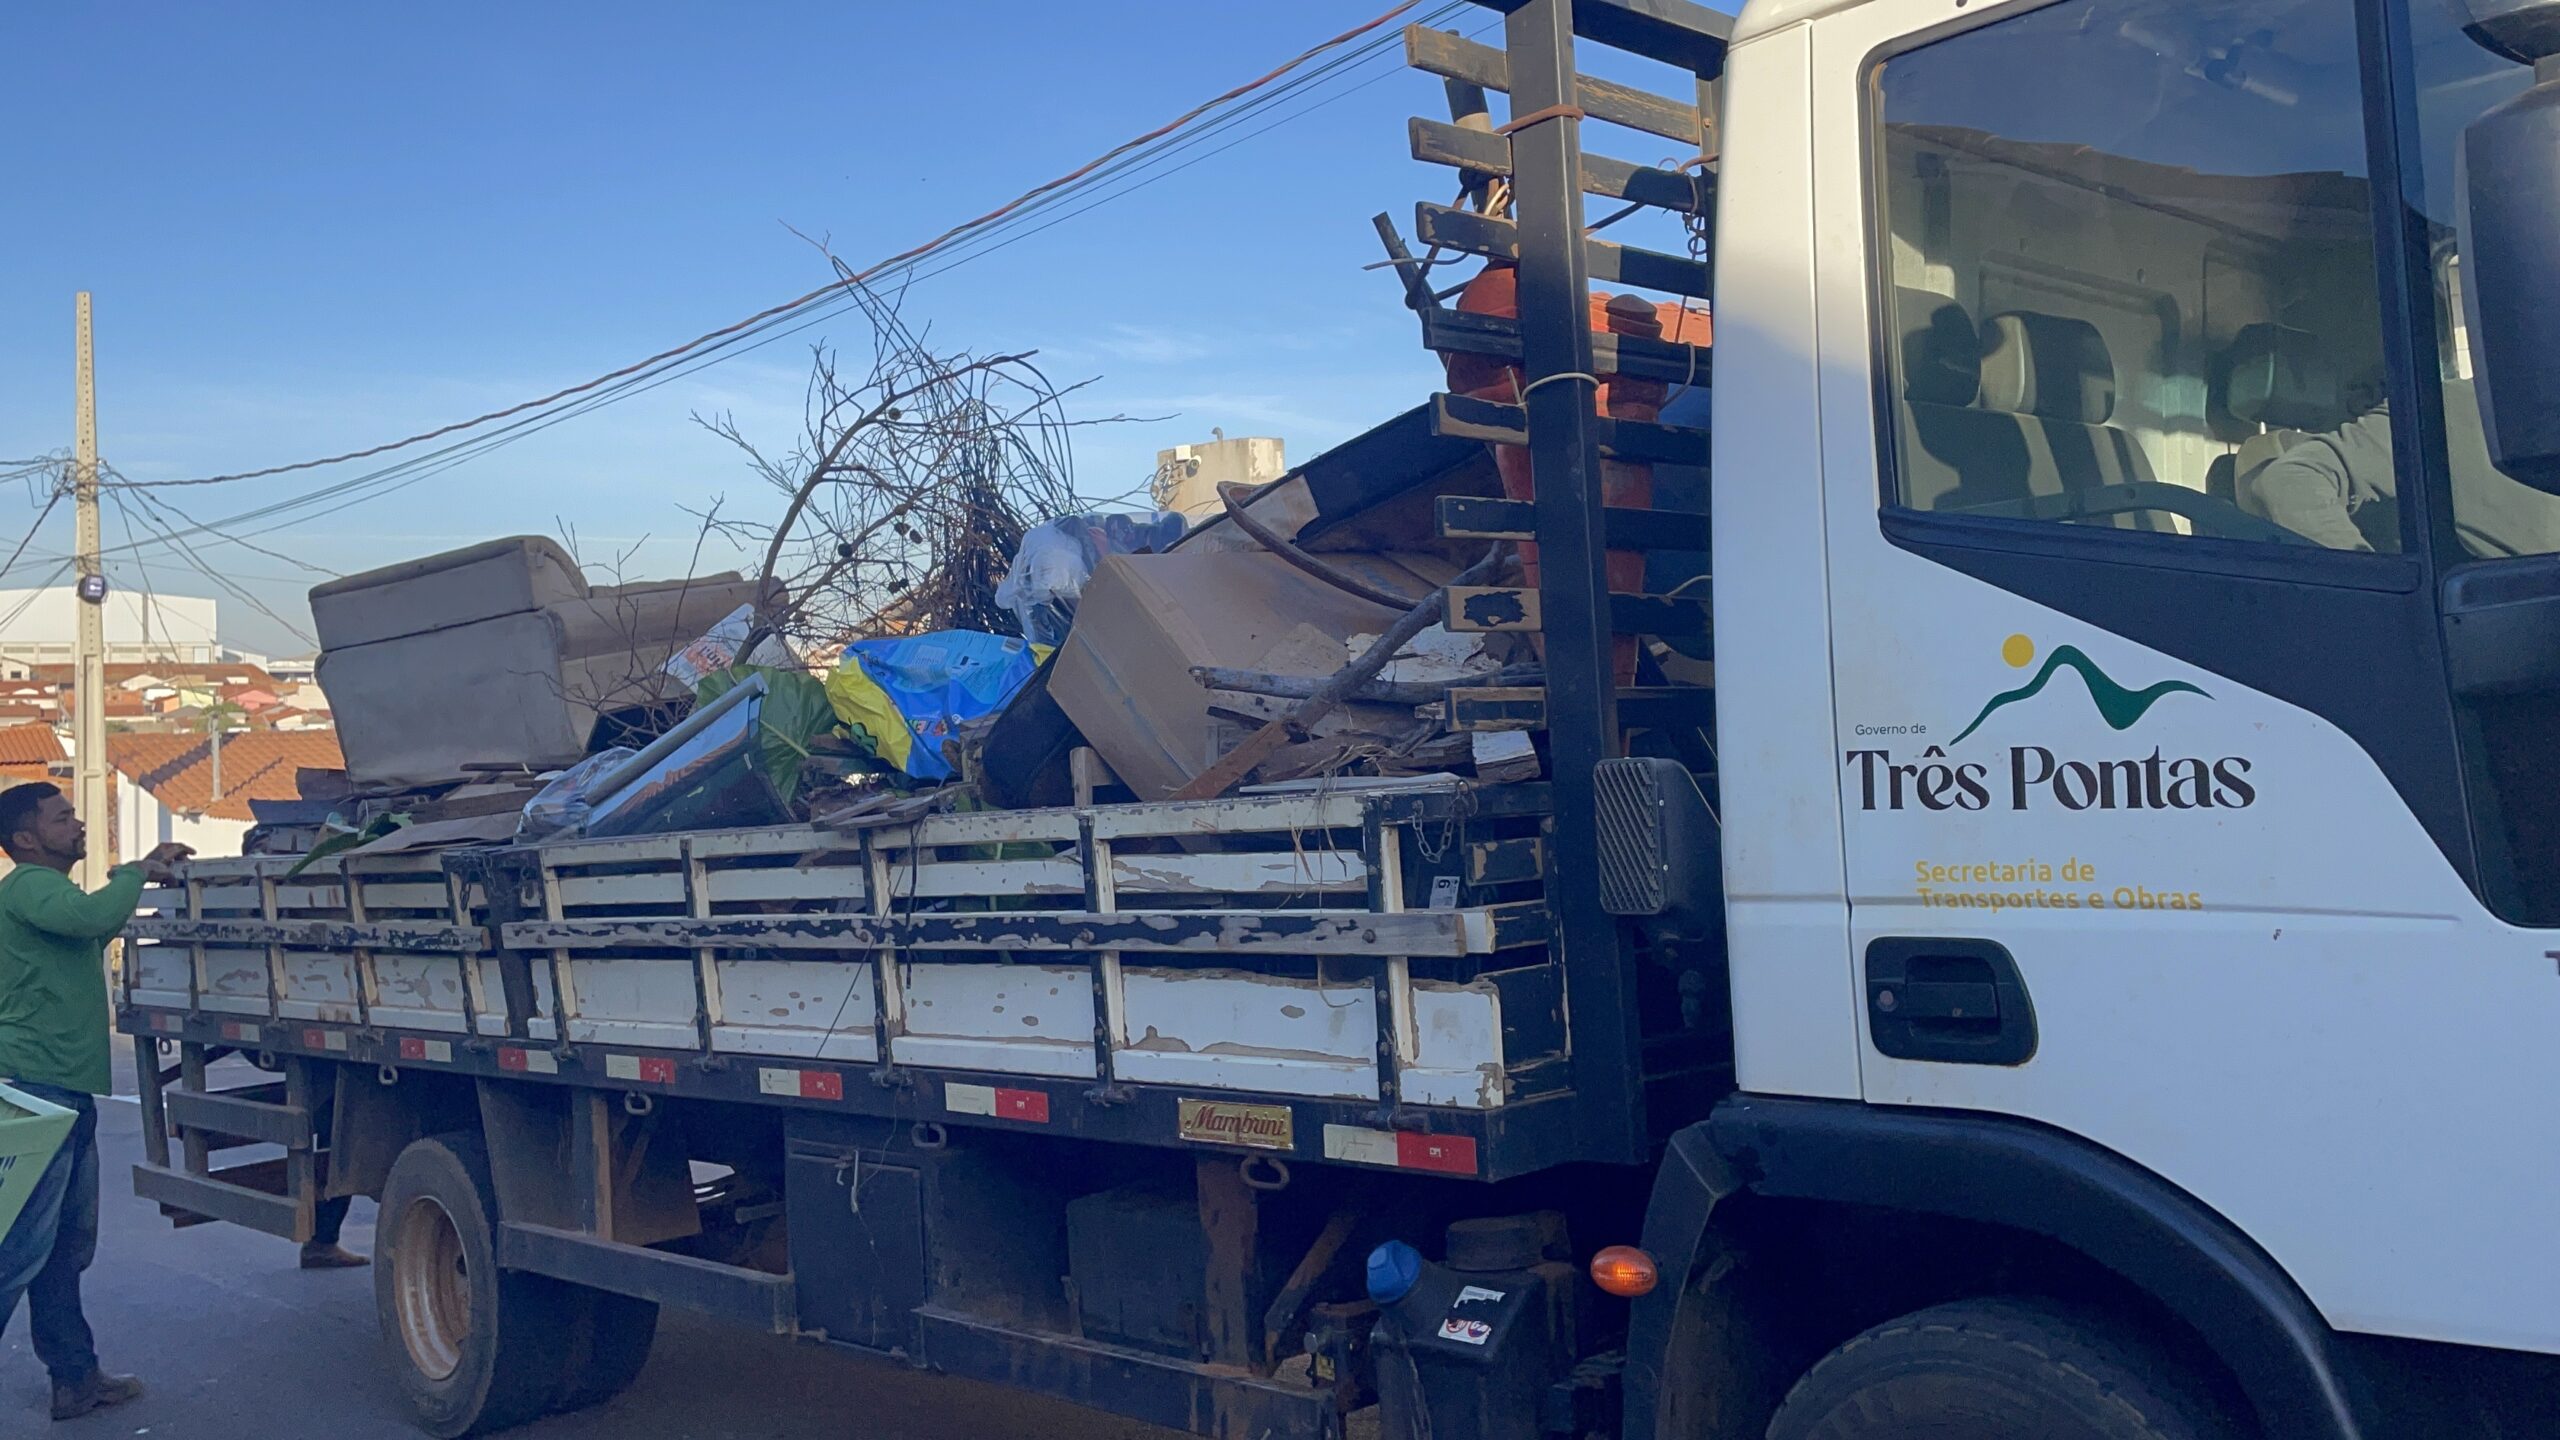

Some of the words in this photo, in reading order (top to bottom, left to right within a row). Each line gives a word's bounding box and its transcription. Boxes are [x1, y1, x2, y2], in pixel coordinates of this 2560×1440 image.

[1854, 723, 1908, 736] Governo
[1910, 722, 1927, 735] de
[1846, 744, 1991, 811] Três
[2009, 744, 2257, 811] Pontas
[1914, 859, 2053, 883] Secretaria
[2061, 856, 2096, 883] de
[1917, 887, 2082, 913] Transportes
[2088, 891, 2106, 910] e
[2112, 885, 2204, 911] Obras
[1184, 1104, 1288, 1137] Mambrini
